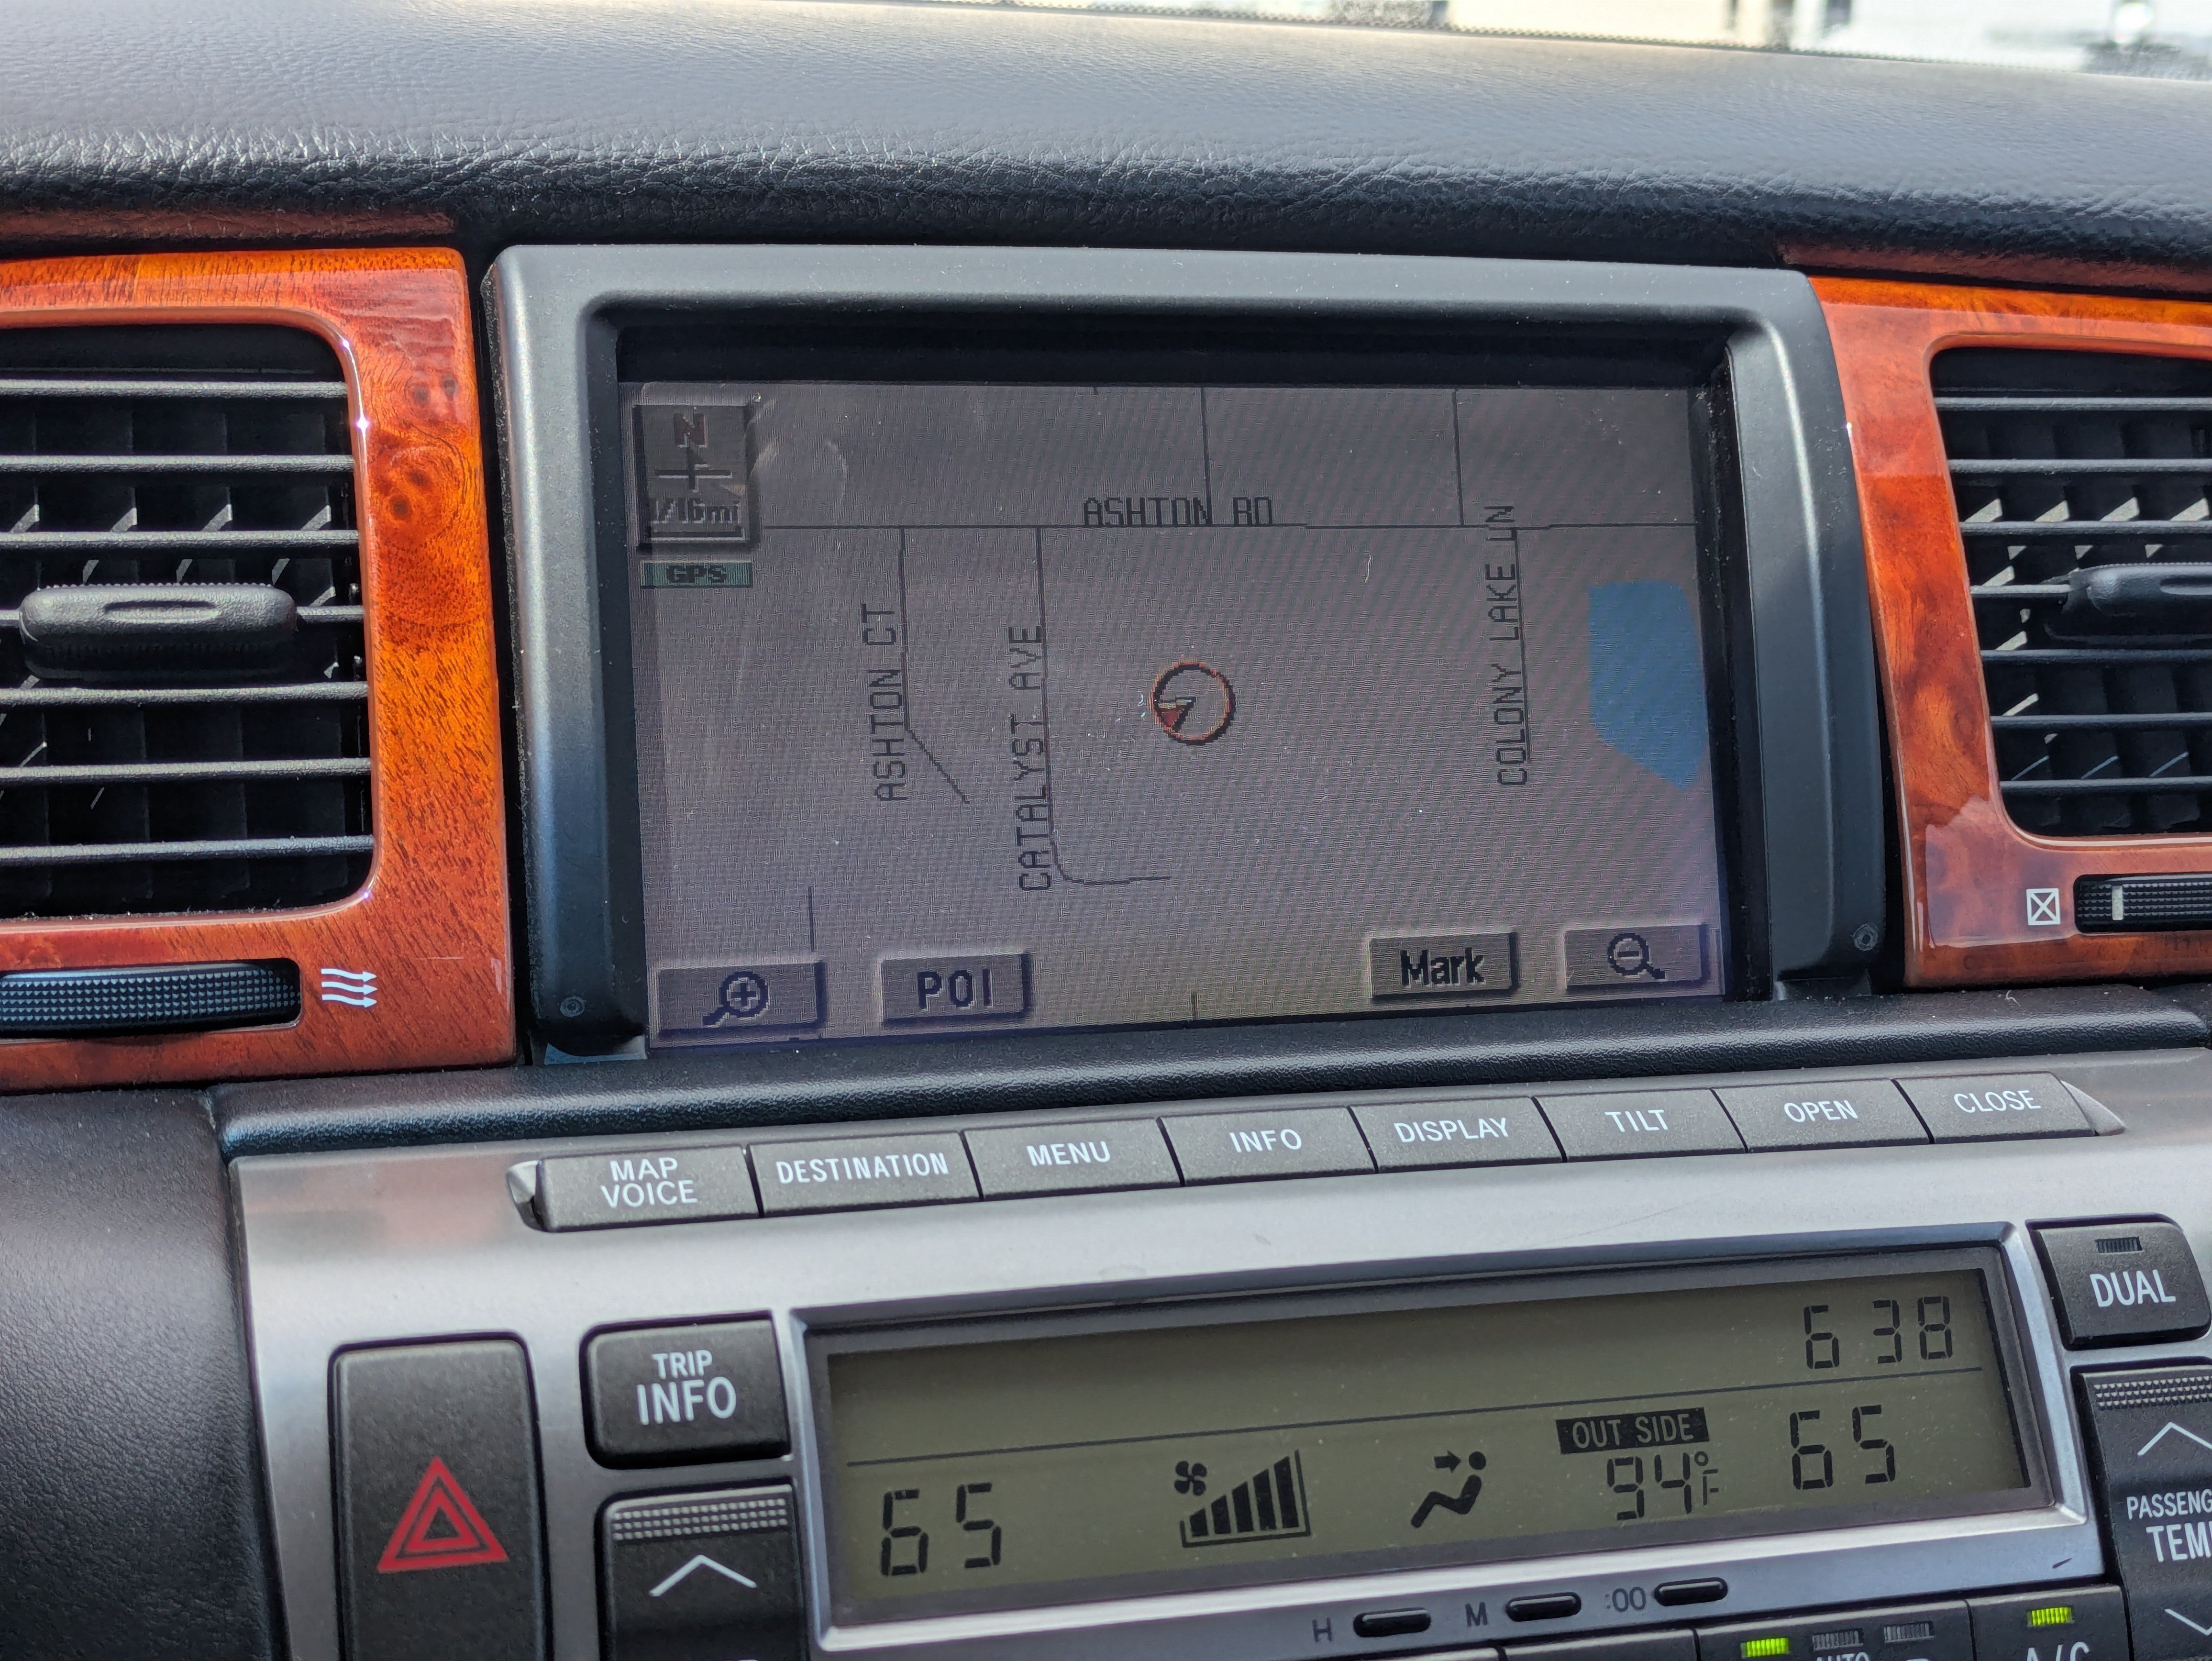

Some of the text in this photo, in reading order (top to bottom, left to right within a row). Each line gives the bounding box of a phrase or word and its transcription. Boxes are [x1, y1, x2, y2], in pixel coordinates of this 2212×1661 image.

[674, 412, 707, 447] N
[1084, 496, 1273, 526] ASHTON RD
[667, 565, 727, 584] GPS
[1484, 506, 1527, 786] COLONY LAKE LN
[862, 603, 908, 801] ASHTON CT
[1007, 626, 1051, 891] CATALYST AVE
[1400, 947, 1486, 986] Mark
[918, 969, 993, 1011] POI
[1783, 1099, 1858, 1123] OPEN
[1953, 1090, 2041, 1114] CLOSE
[1393, 1117, 1509, 1143] DISPLAY
[1604, 1109, 1671, 1132] TILT
[1026, 1141, 1112, 1167] MENU
[1229, 1129, 1302, 1153] INFO
[609, 1157, 678, 1181] MAP
[776, 1152, 950, 1185] DESTINATION
[601, 1179, 698, 1208] VOICE
[2089, 1269, 2176, 1308] DUAL
[652, 1350, 712, 1379] TRIP
[637, 1376, 737, 1425] INFO
[1571, 1413, 1694, 1449] OUT SIDE
[1790, 1405, 1895, 1490] 65
[2126, 1489, 2212, 1520] PASSENG
[881, 1482, 1002, 1576] 65
[2146, 1520, 2212, 1562] TEM
[1466, 1603, 1487, 1627] M
[1313, 1619, 1332, 1643] H
